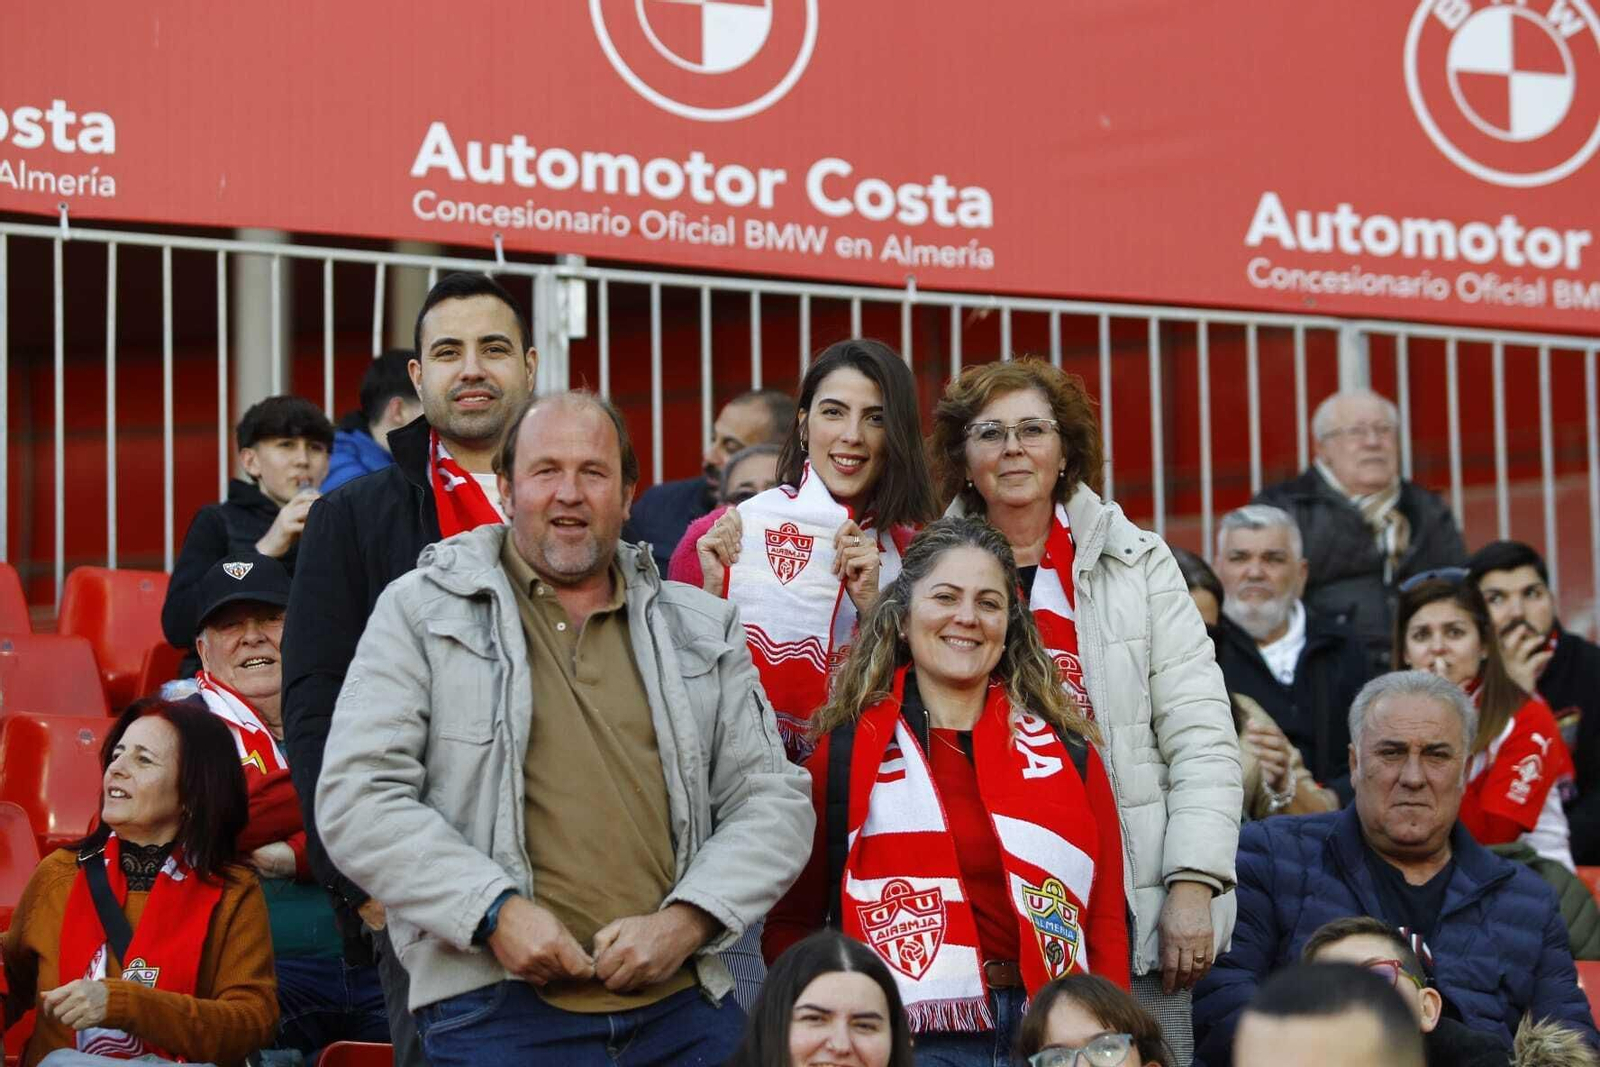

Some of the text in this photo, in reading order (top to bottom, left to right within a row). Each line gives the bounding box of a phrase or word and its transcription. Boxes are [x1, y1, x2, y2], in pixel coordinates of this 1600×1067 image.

[0, 99, 116, 154] sta
[0, 159, 116, 197] Almería
[410, 121, 993, 228] Automotor Costa
[412, 190, 995, 269] Concesionario Oficial BMW en Almería
[1245, 191, 1592, 270] Automotor
[1247, 257, 1449, 301] Concesionario
[1456, 271, 1548, 306] Oficial
